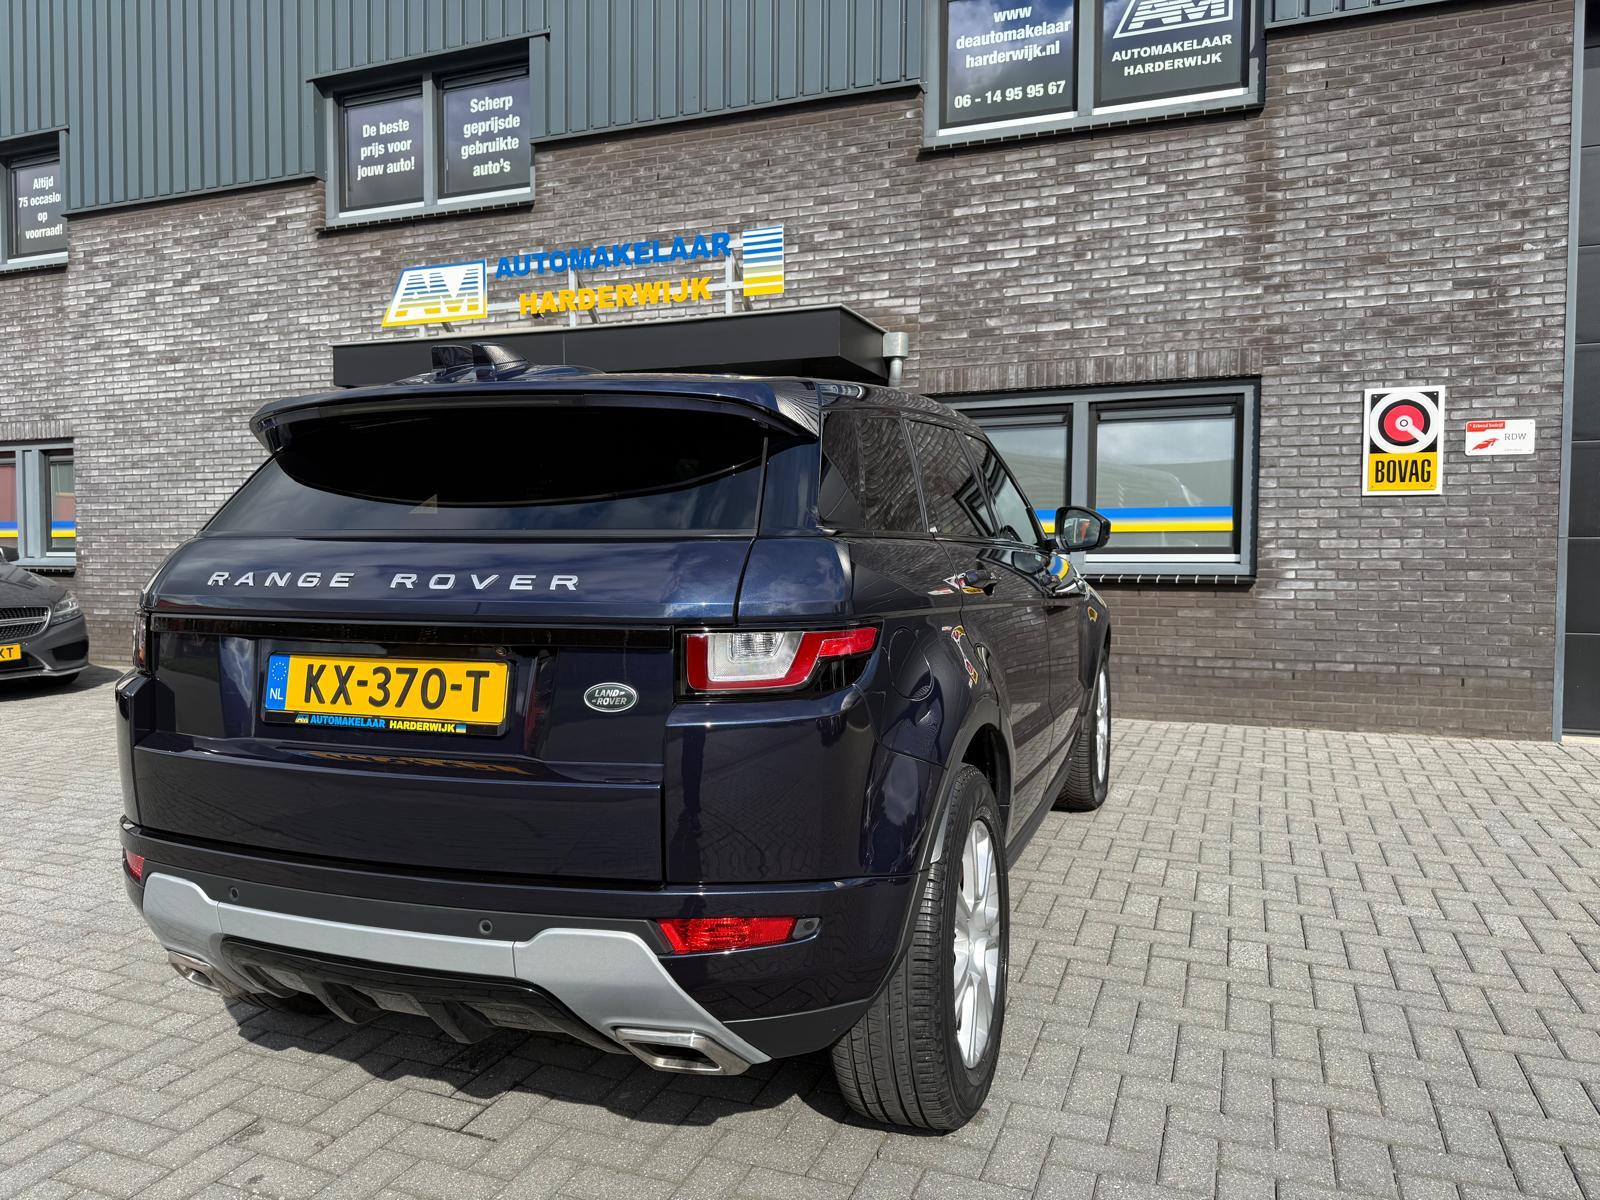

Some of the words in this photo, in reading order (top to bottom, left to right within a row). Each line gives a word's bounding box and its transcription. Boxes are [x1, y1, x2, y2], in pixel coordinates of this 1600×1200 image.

[993, 6, 1033, 23] www
[955, 19, 1072, 50] deautomakelaar
[965, 40, 1060, 69] harderwijk.nl
[1111, 33, 1232, 62] AUTOMAKELAAR
[1123, 52, 1222, 77] HARDERWIJK
[469, 95, 513, 113] Scherp
[954, 94, 972, 109] 06
[985, 89, 1003, 104] 14
[1005, 86, 1023, 102] 95
[1026, 83, 1044, 98] 95
[1047, 80, 1066, 95] 67
[362, 124, 377, 138] De
[379, 119, 410, 134] beste
[463, 114, 521, 138] geprijsde
[360, 141, 385, 161] prijs
[387, 138, 412, 154] voor
[460, 135, 520, 160] gebruikte
[356, 163, 384, 181] jouw
[386, 156, 415, 174] auto!
[472, 158, 511, 178] auto's
[32, 175, 54, 190] Altijd
[18, 196, 29, 208] 75
[30, 192, 61, 207] occasio
[37, 211, 48, 223] op
[25, 223, 63, 240] voorraad!
[495, 231, 731, 279] AUTOMAKELAAR
[519, 275, 712, 317] HARDERWIJK
[1504, 432, 1527, 441] RDW
[1374, 458, 1432, 484] BOVAG
[207, 571, 355, 587] RANGE
[390, 573, 580, 591] ROVER
[269, 687, 284, 701] NL
[304, 663, 491, 713] KX-370-T
[310, 714, 386, 729] AUTOMAKELAAR
[389, 719, 455, 733] HARDERWIJK
